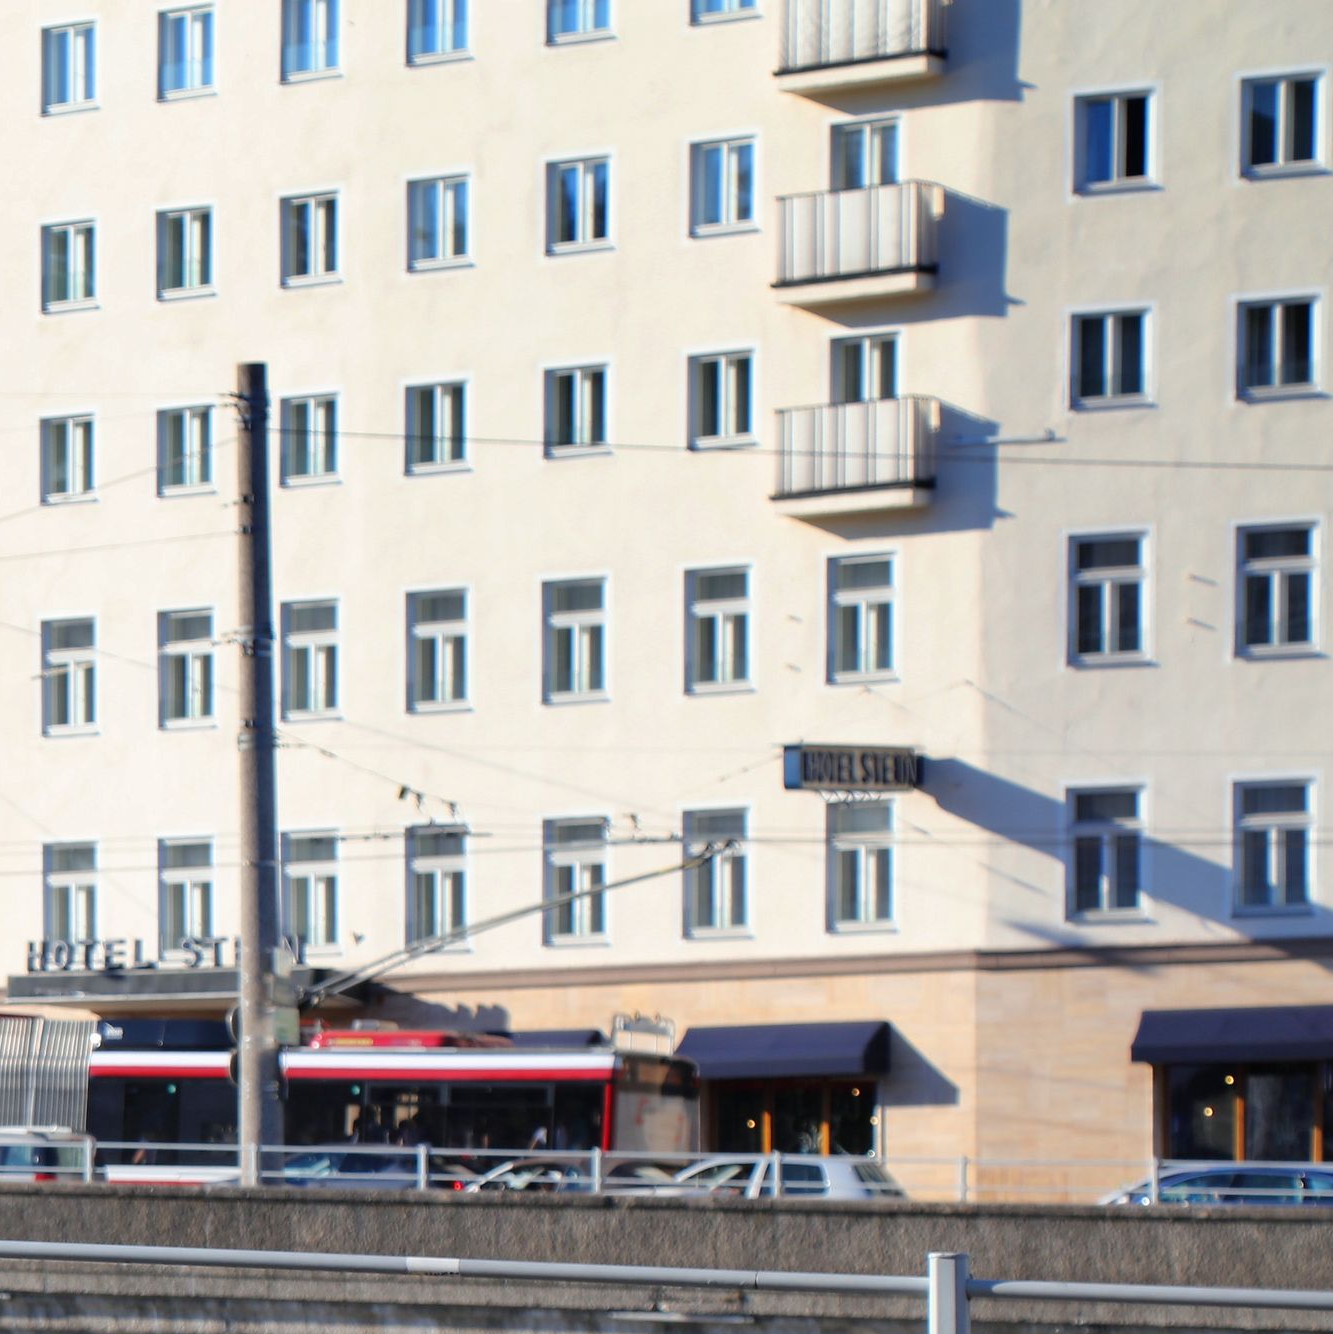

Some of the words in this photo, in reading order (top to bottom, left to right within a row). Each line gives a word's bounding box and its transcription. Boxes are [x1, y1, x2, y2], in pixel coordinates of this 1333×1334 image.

[802, 751, 854, 784] HOTEL
[860, 752, 918, 787] STEIN
[26, 937, 158, 973] HOTEL
[182, 935, 303, 968] STN
